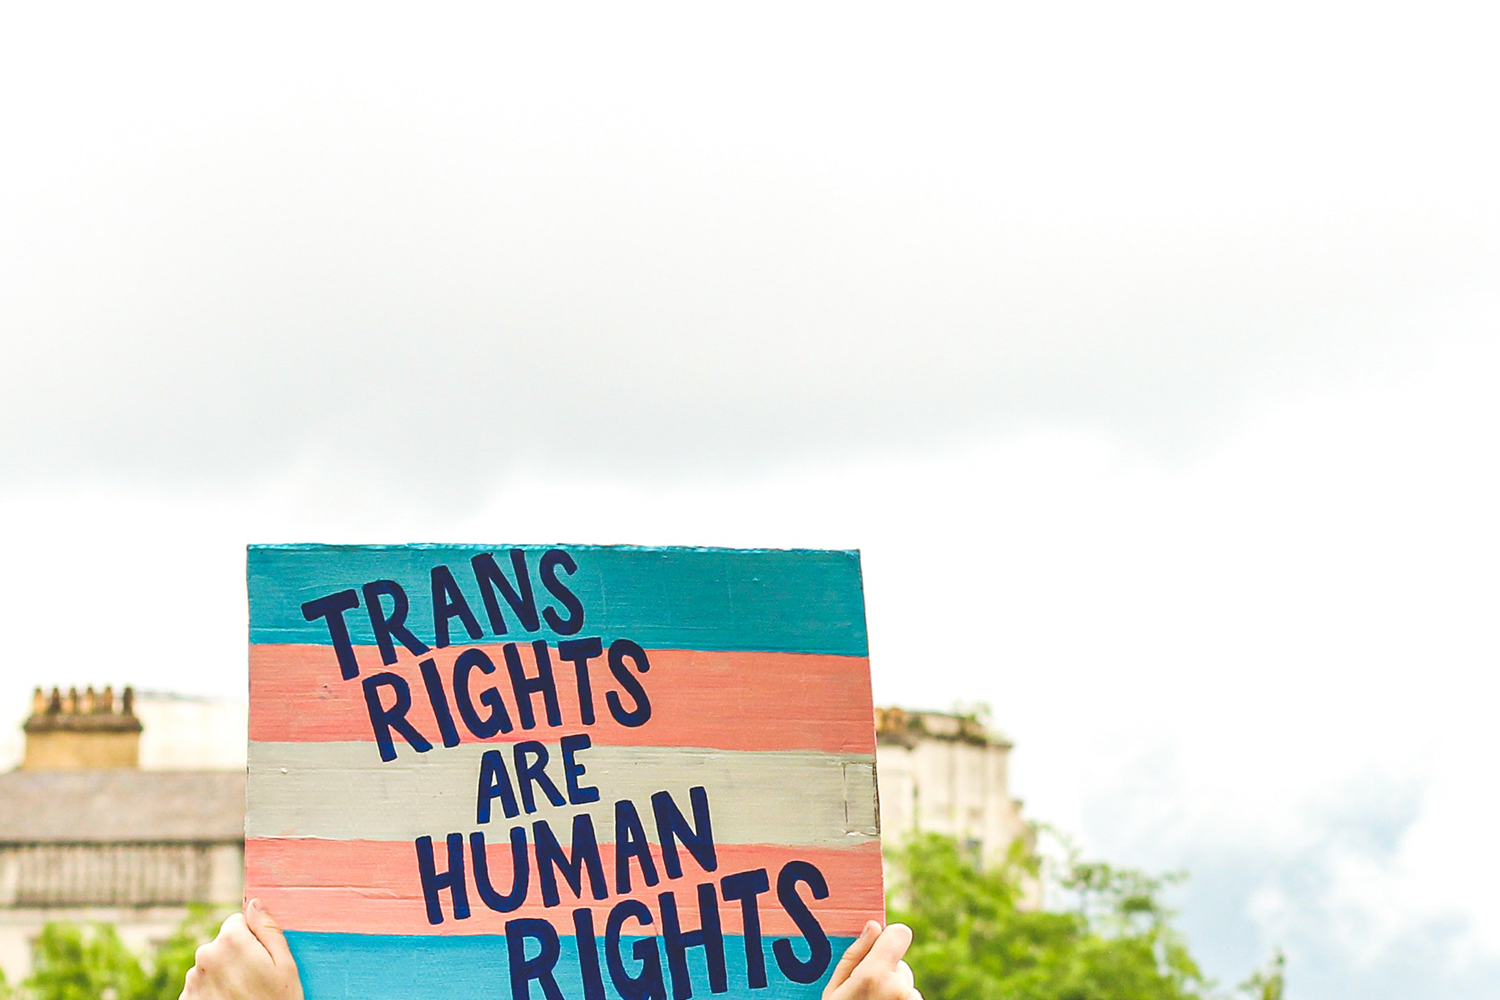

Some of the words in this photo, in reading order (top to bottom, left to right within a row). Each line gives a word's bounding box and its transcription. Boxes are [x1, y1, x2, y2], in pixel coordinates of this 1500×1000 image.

[300, 548, 584, 681] TRANS
[361, 636, 651, 763] RIGHTS
[476, 734, 600, 825] ARE
[415, 786, 718, 925] HUMAN
